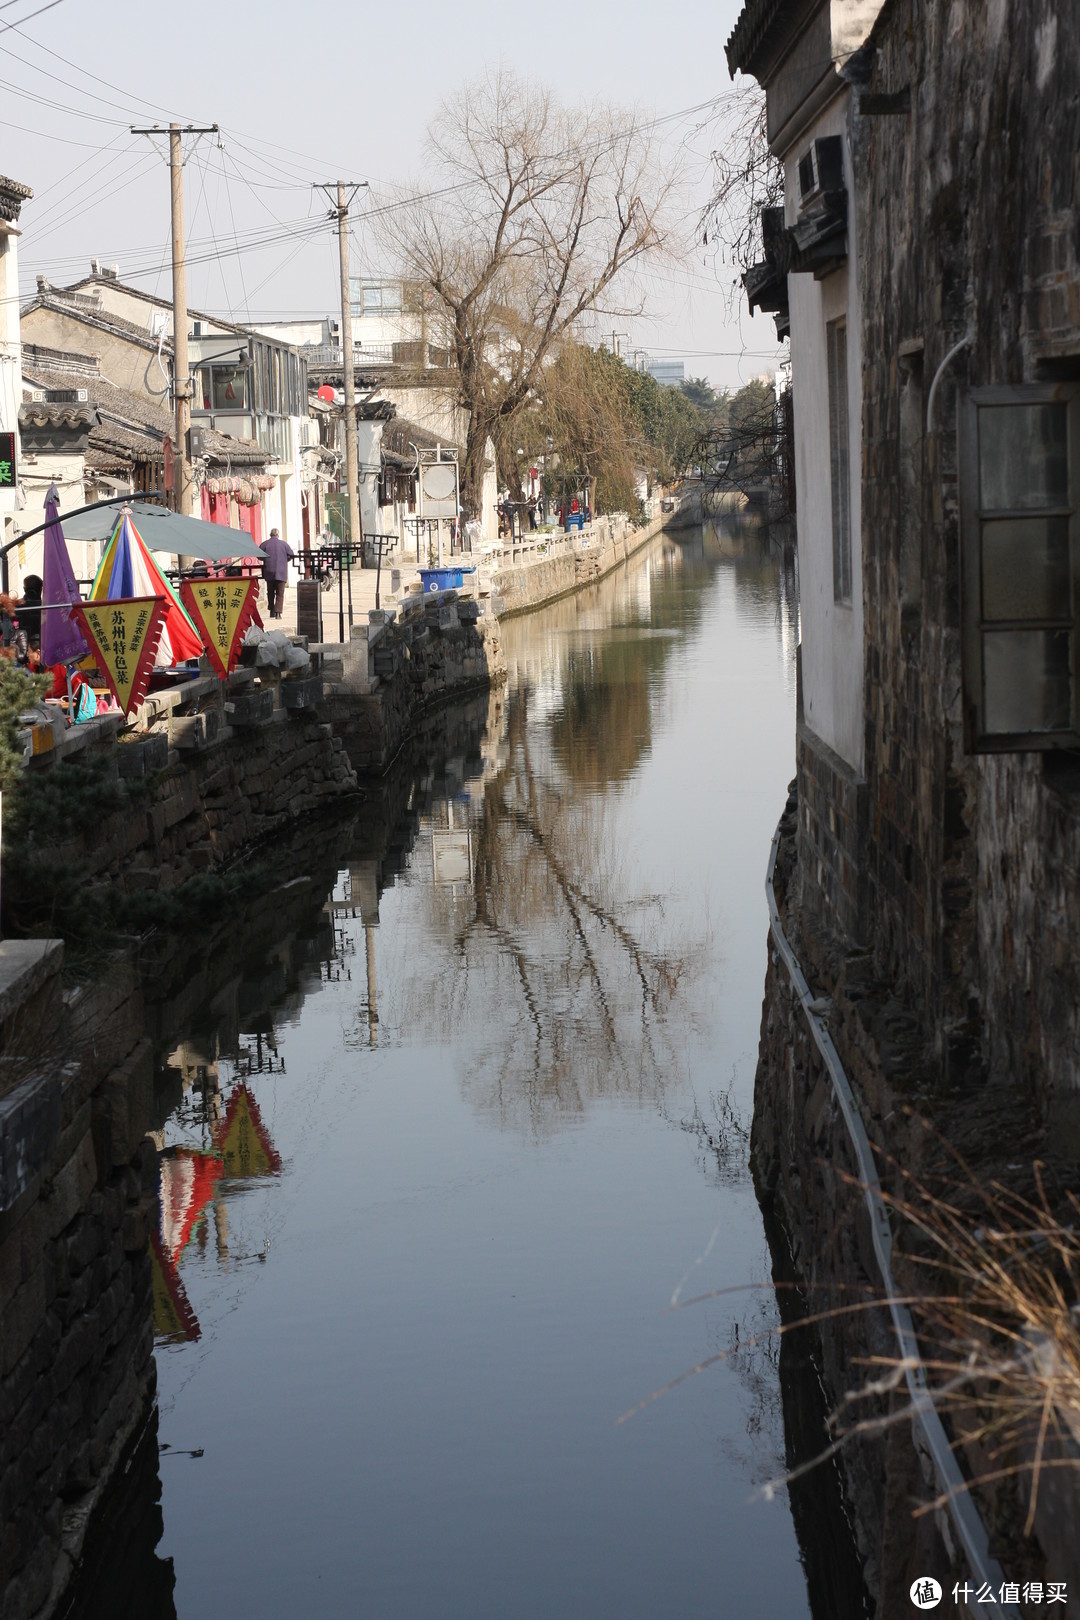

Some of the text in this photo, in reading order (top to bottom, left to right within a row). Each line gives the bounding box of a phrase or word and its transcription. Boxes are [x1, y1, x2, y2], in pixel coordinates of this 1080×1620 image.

[199, 588, 213, 608] 经典
[215, 586, 228, 647] 苏州特色菜
[230, 588, 244, 608] 正宗
[112, 611, 129, 685] 苏州特色菜
[129, 609, 148, 652] 正宗农家菜
